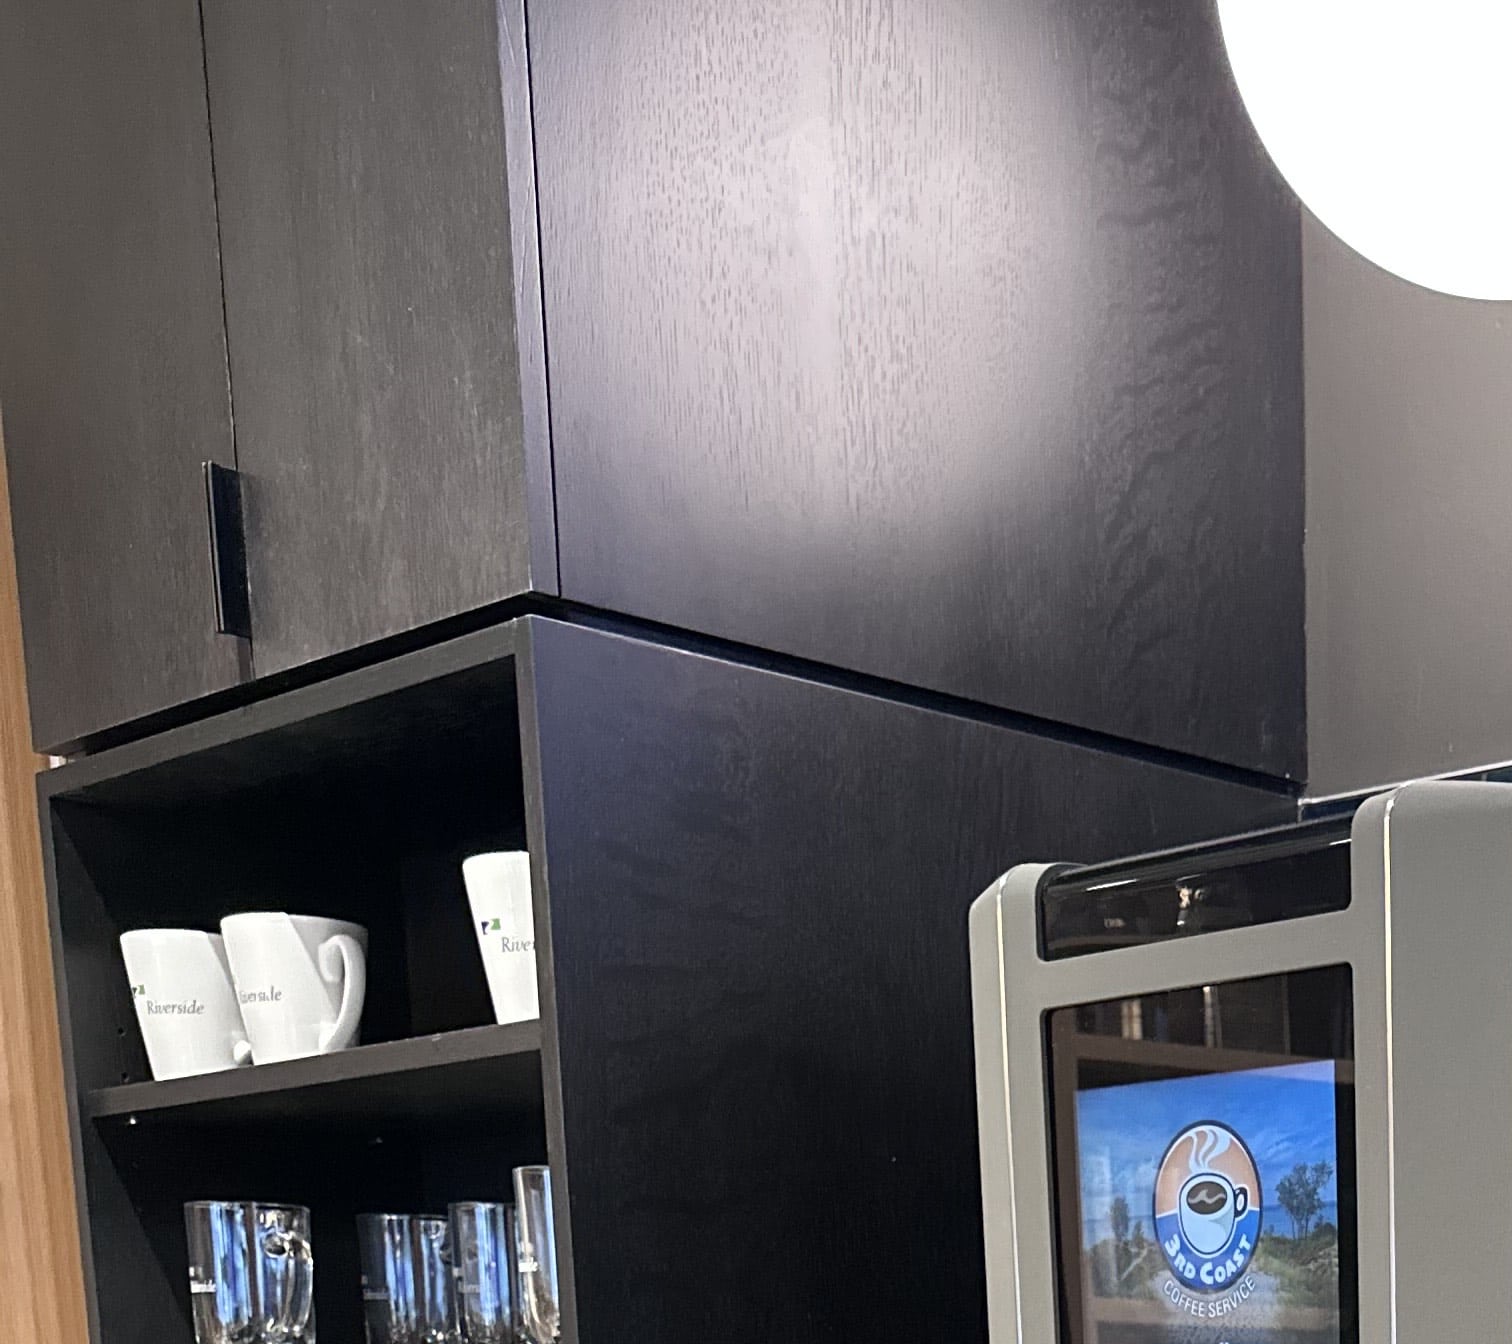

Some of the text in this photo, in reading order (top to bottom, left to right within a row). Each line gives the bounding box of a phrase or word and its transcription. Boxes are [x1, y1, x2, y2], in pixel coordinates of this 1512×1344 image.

[146, 1000, 205, 1015] Riverside
[1164, 1233, 1197, 1279] 3RD
[1163, 1275, 1256, 1318] COFFEE SERVICE
